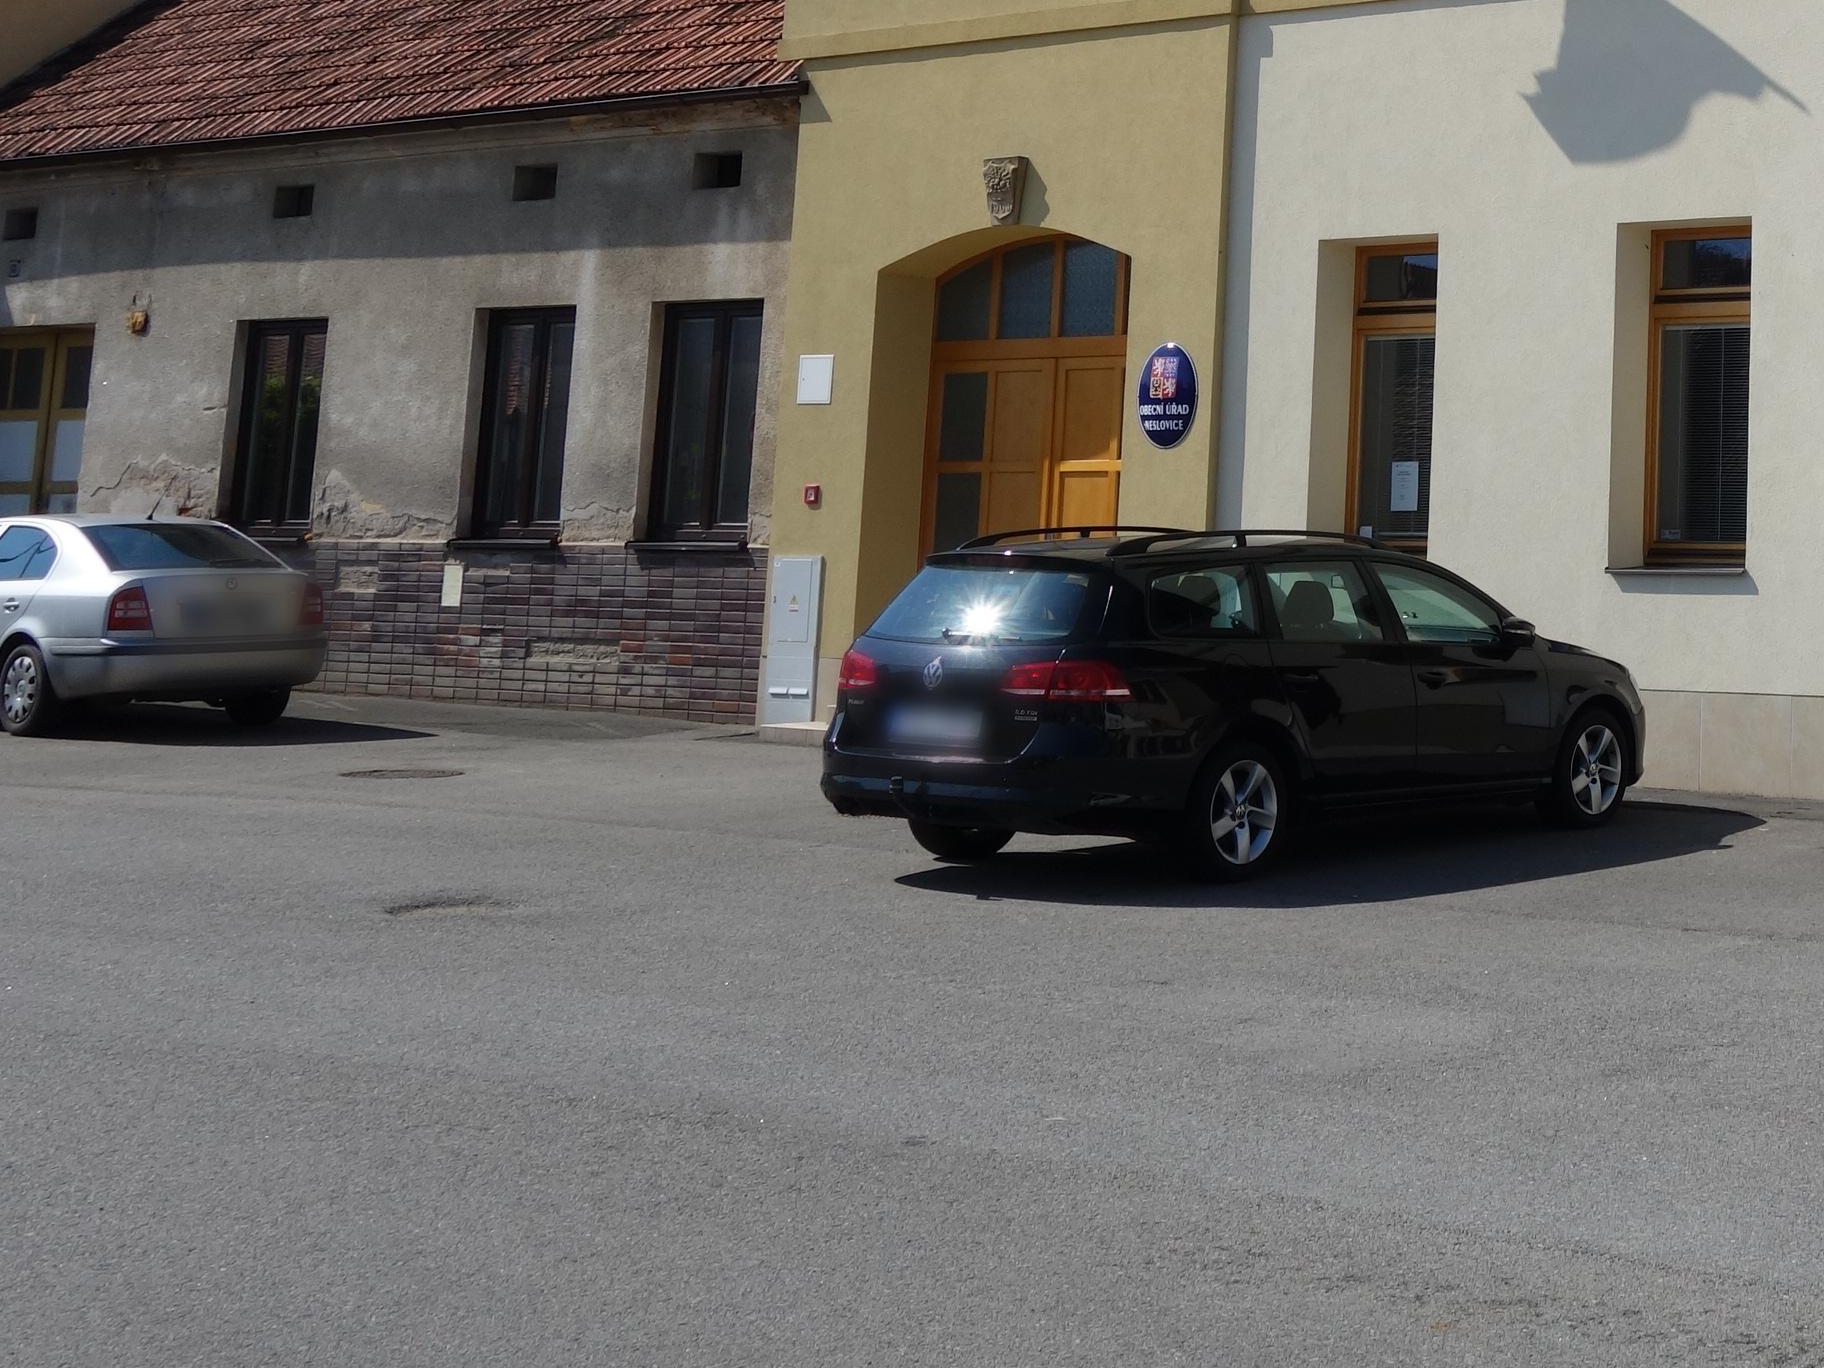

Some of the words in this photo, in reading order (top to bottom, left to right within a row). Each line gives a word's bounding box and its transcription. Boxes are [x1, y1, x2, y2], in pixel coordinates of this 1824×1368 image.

[1139, 402, 1164, 415] OBECNÍ
[1165, 401, 1190, 415] ÚŘAD
[1144, 419, 1184, 431] NESLOVICE
